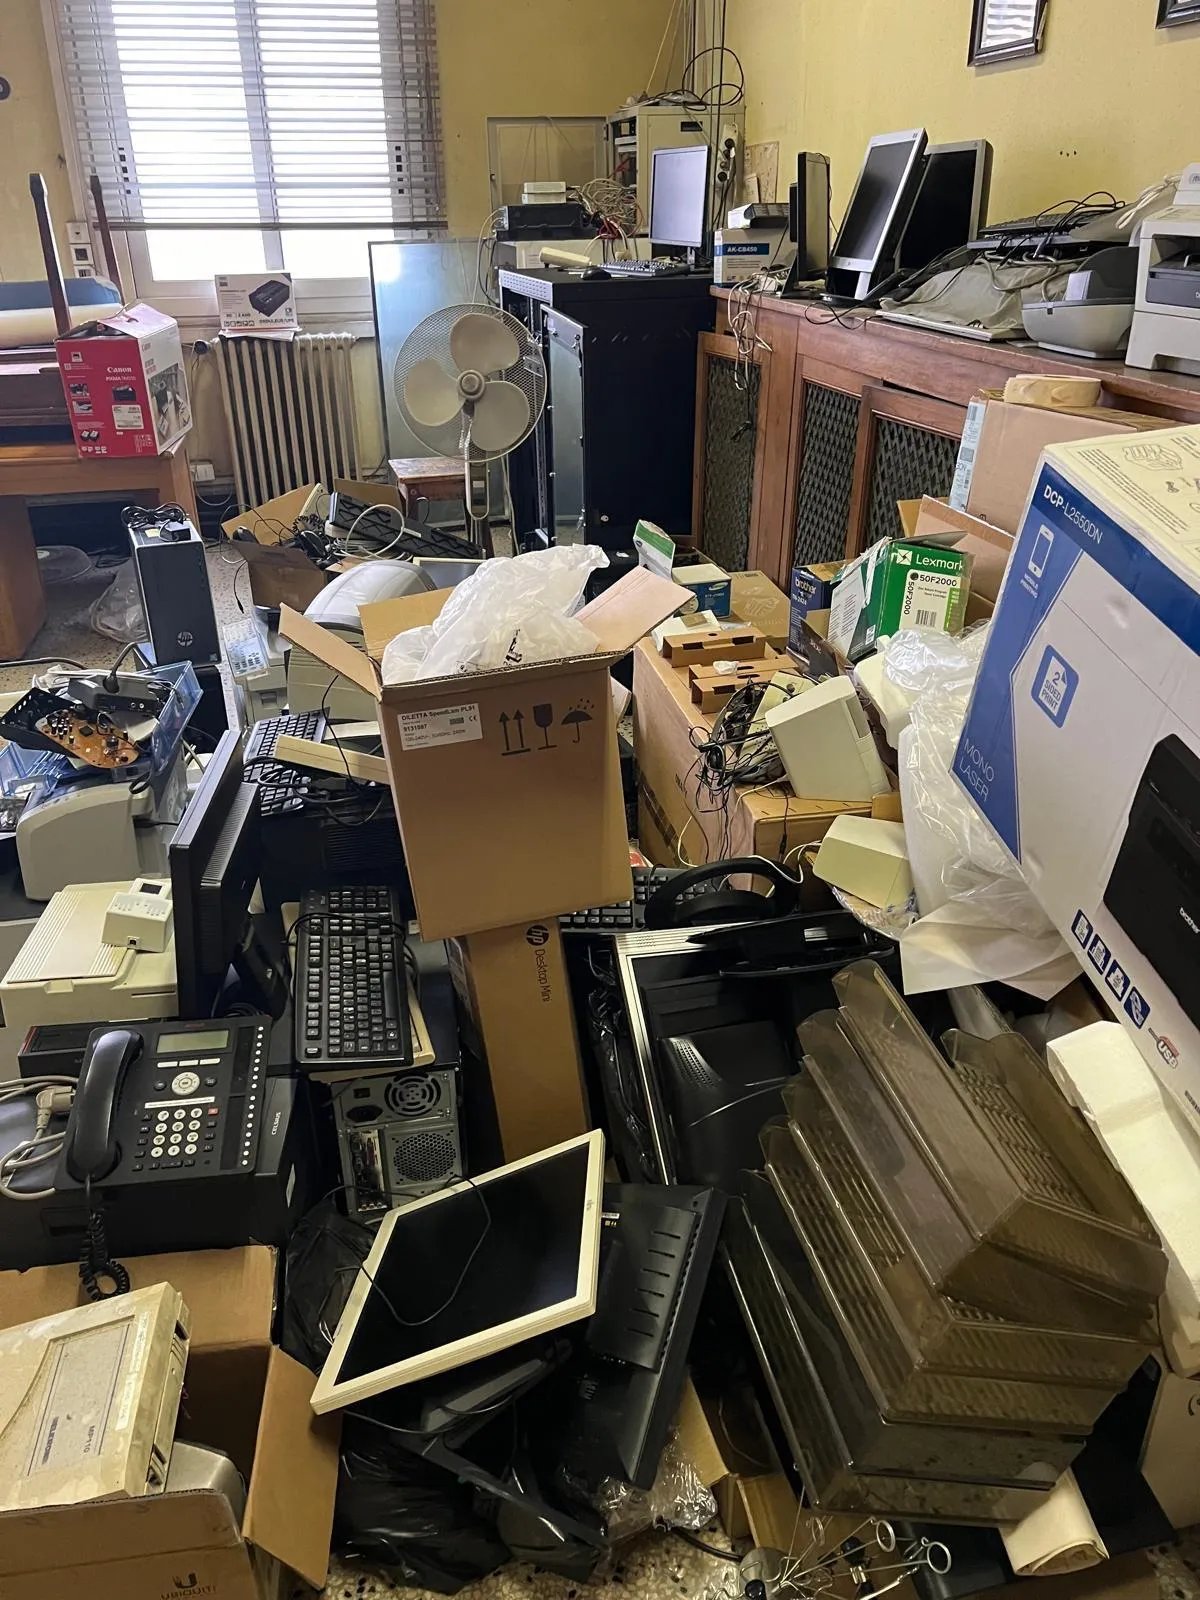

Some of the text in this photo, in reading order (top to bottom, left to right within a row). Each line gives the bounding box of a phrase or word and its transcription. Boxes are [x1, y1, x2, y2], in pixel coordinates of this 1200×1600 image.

[1043, 484, 1103, 544] DCP-L2550DN
[795, 576, 817, 595] brother
[919, 574, 958, 587] 50F2000
[903, 581, 915, 615] 50F2000
[1044, 680, 1062, 702] SIDED
[1052, 671, 1061, 687] 2
[1041, 690, 1059, 710] PRINT
[963, 738, 995, 782] MONO
[959, 757, 989, 802] LASER
[526, 925, 550, 947] hp
[535, 948, 553, 1002] Desktop Mini
[1158, 1040, 1178, 1069] USB
[271, 1111, 281, 1136] CELSIUS
